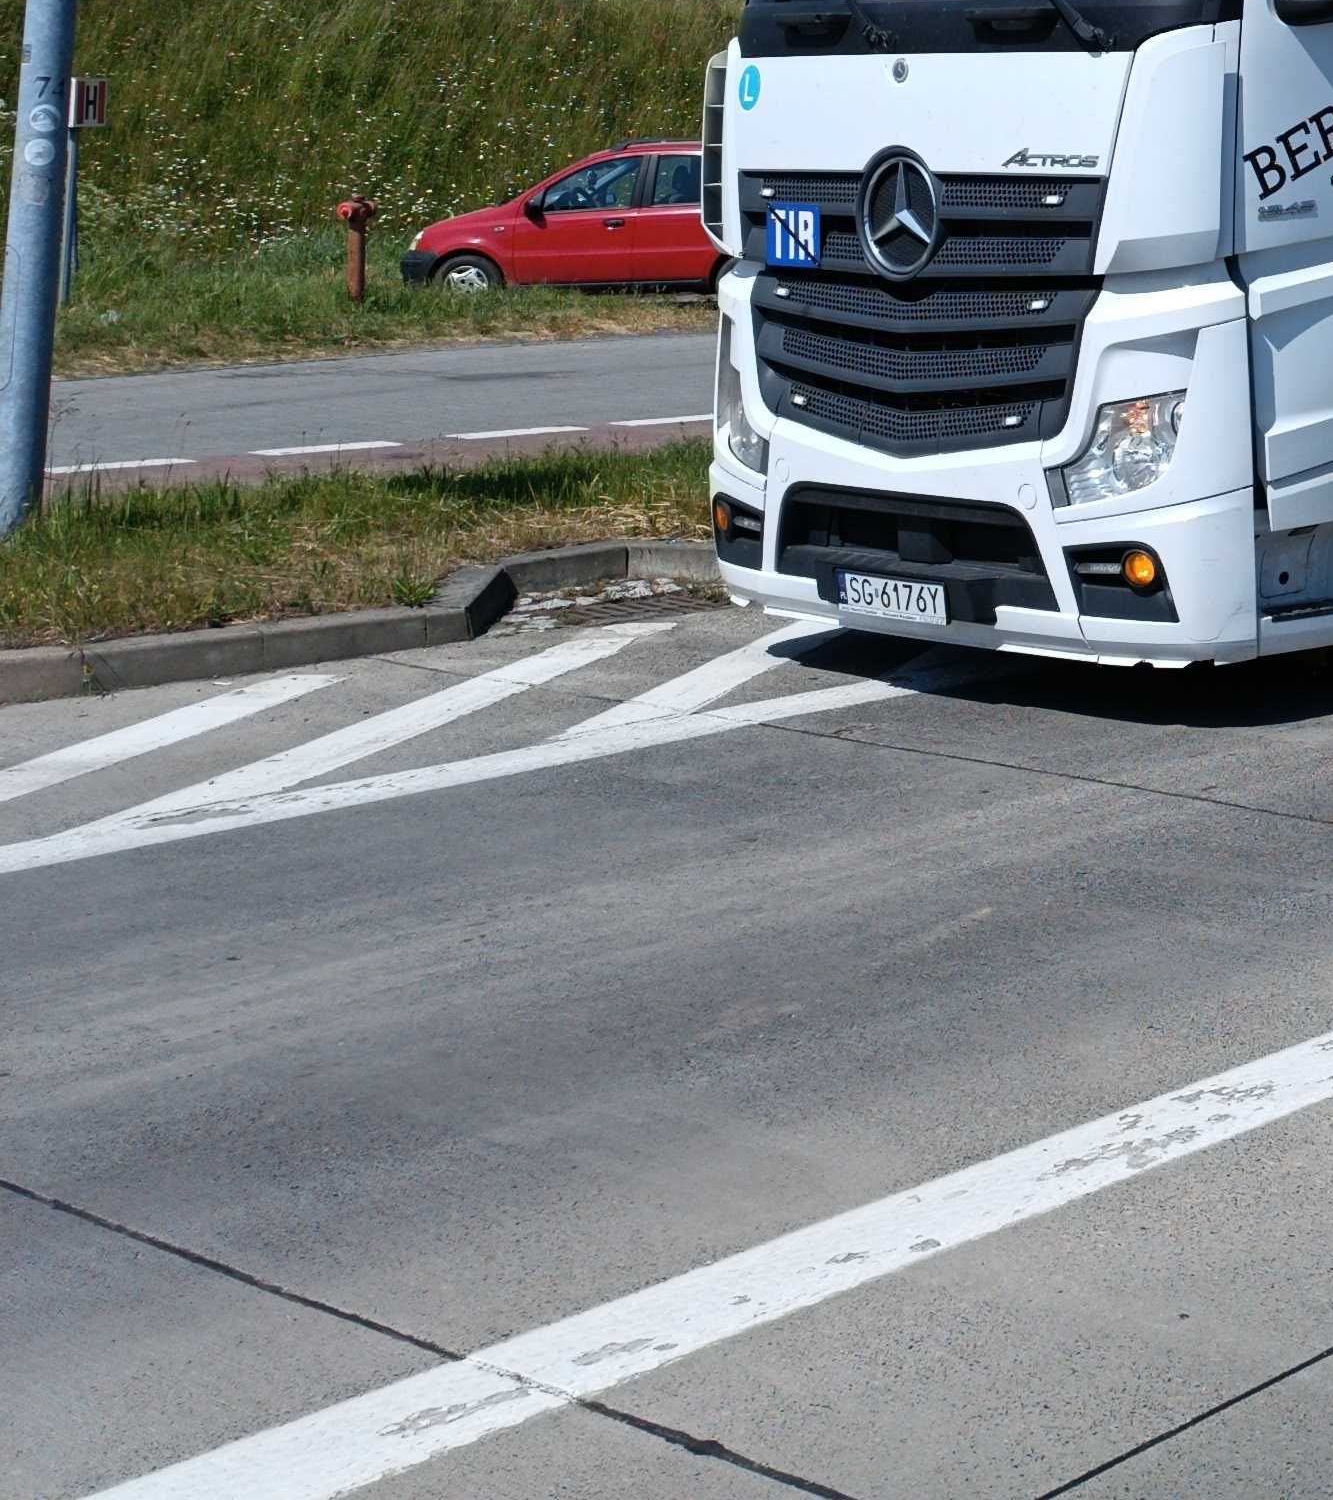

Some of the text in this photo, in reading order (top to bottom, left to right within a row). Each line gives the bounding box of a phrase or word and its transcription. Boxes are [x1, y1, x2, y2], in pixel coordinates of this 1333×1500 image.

[85, 85, 98, 120] H
[743, 73, 755, 102] L
[771, 210, 815, 260] TIR
[849, 577, 938, 614] SG 6176Y
